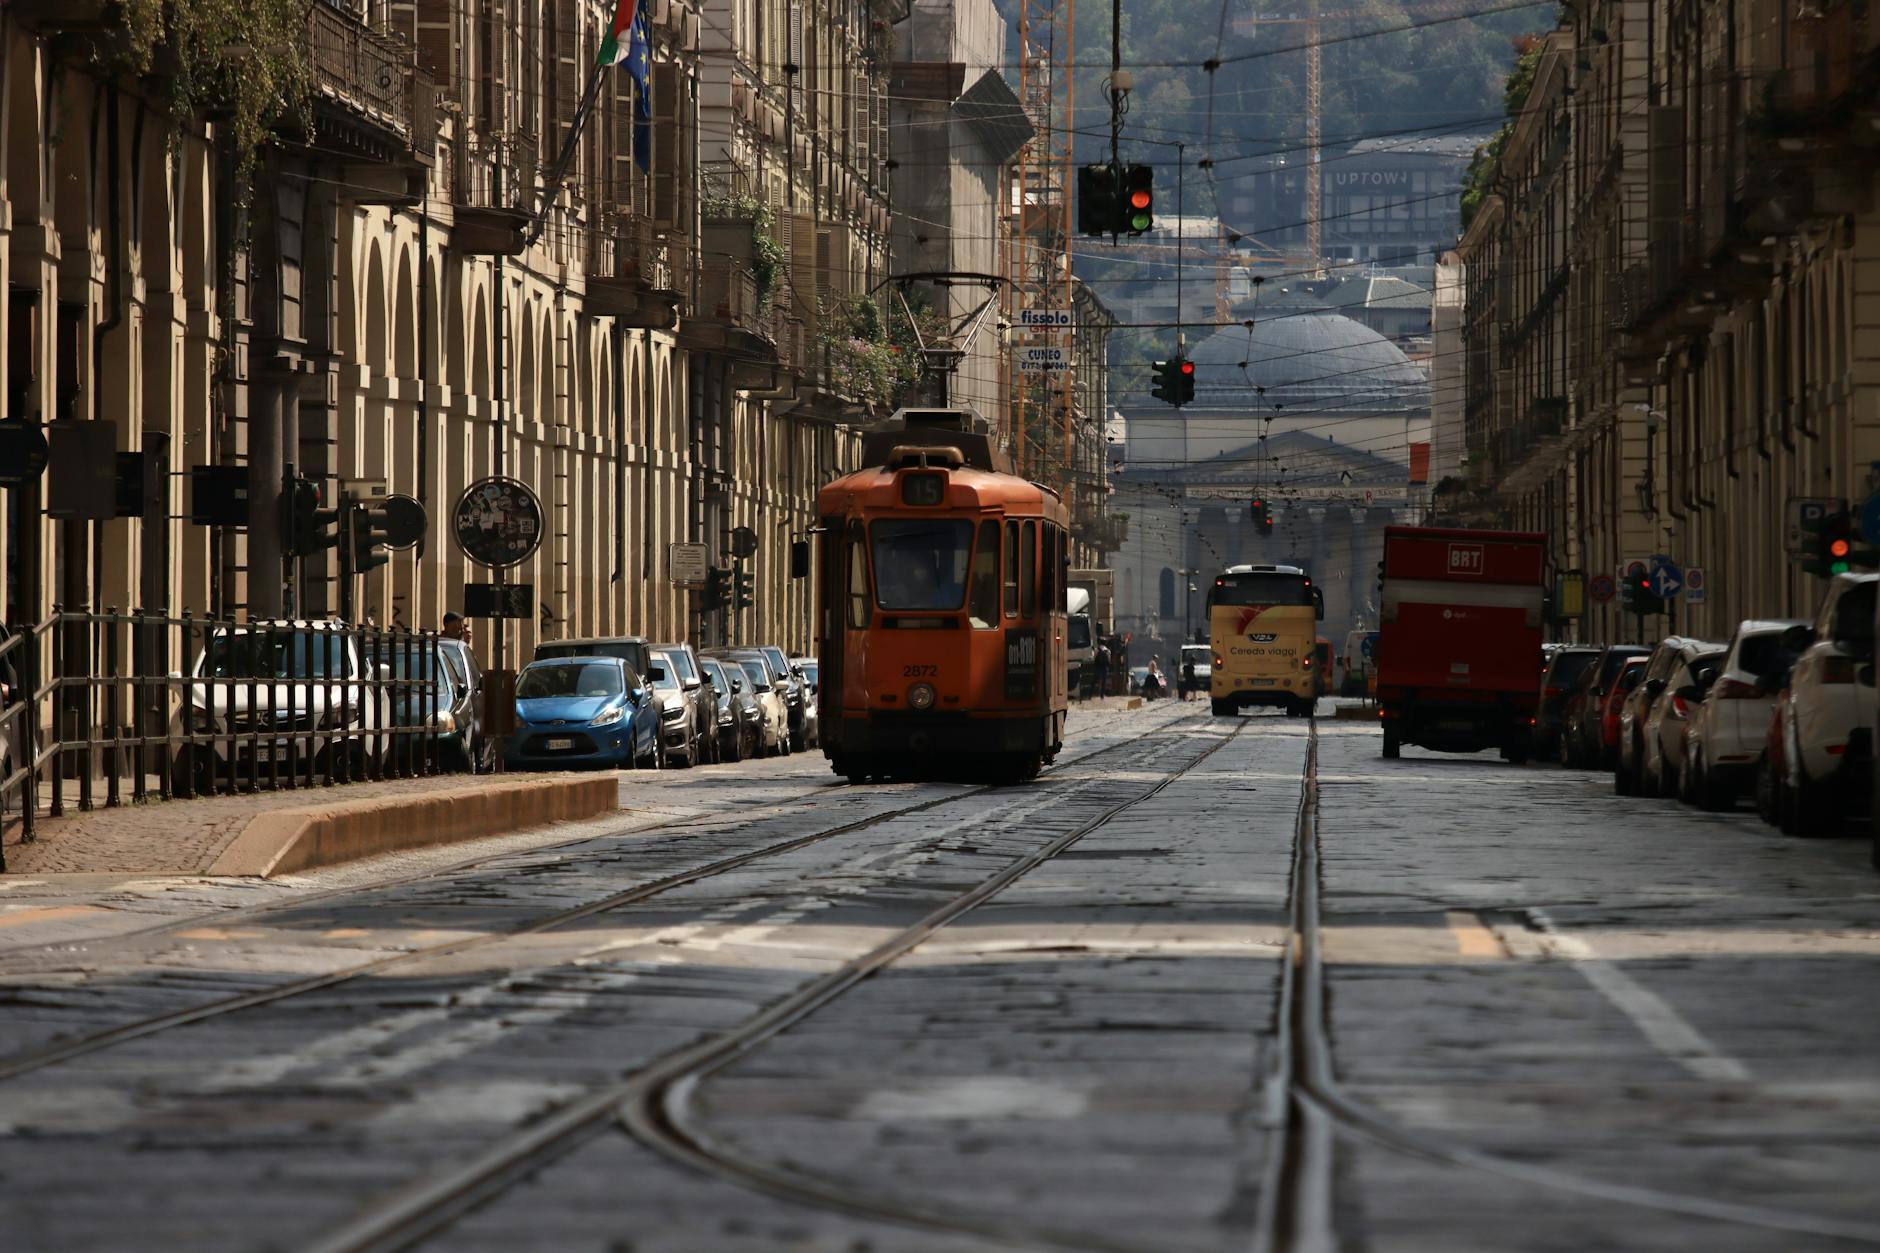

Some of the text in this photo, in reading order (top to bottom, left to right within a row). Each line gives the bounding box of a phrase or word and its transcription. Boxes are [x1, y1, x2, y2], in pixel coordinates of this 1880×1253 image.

[1336, 171, 1407, 185] UPTOWN
[1021, 310, 1068, 324] fissolo
[1028, 349, 1061, 360] CUNEO
[914, 478, 938, 504] 15
[1451, 550, 1480, 568] BRT
[1230, 646, 1297, 657] Cereda viaggi
[903, 664, 938, 678] 2872
